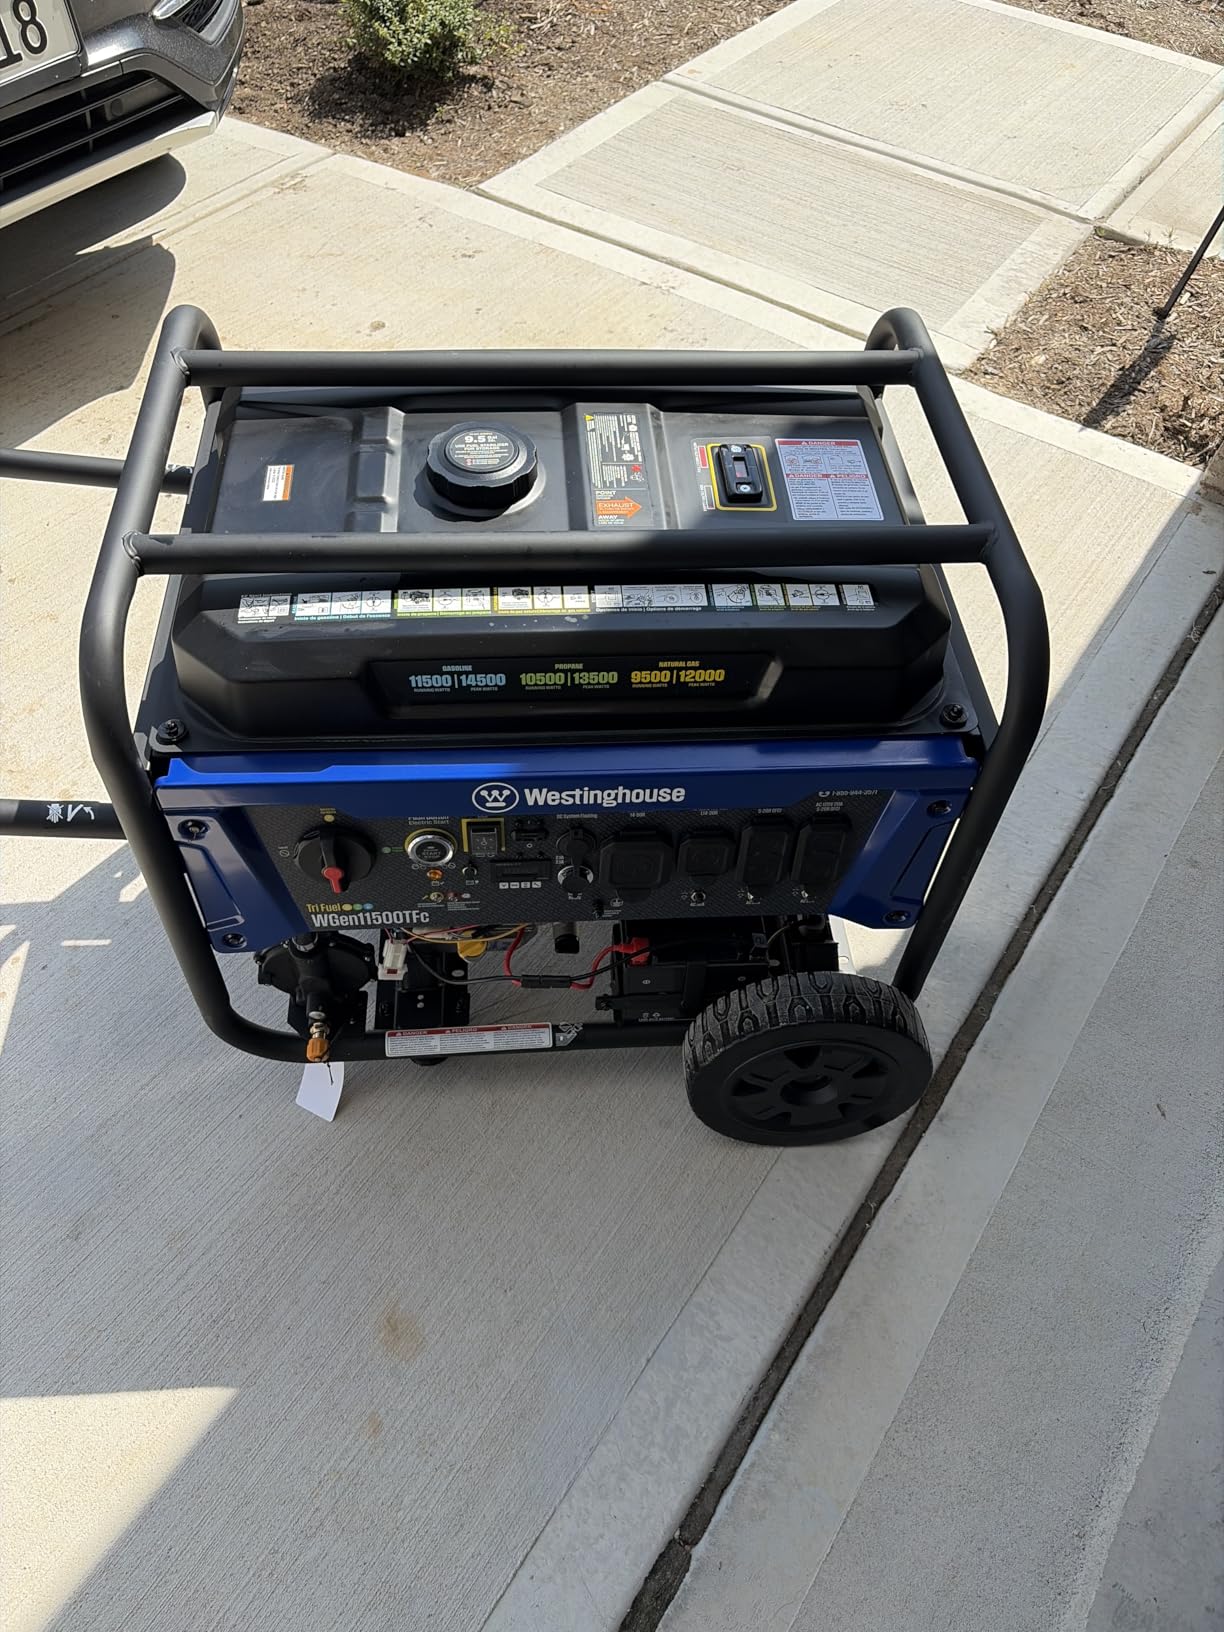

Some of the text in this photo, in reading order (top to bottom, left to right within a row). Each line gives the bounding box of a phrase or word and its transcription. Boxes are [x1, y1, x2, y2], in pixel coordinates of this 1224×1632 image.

[464, 435, 486, 443] 9.5
[408, 673, 506, 688] 11500 14500
[519, 671, 618, 686] 10500 13500
[630, 669, 725, 683] 9500 12000
[523, 786, 686, 807] Westinghouse
[306, 902, 341, 913] Tri Fuel
[311, 910, 430, 927] WGen11500TFc
